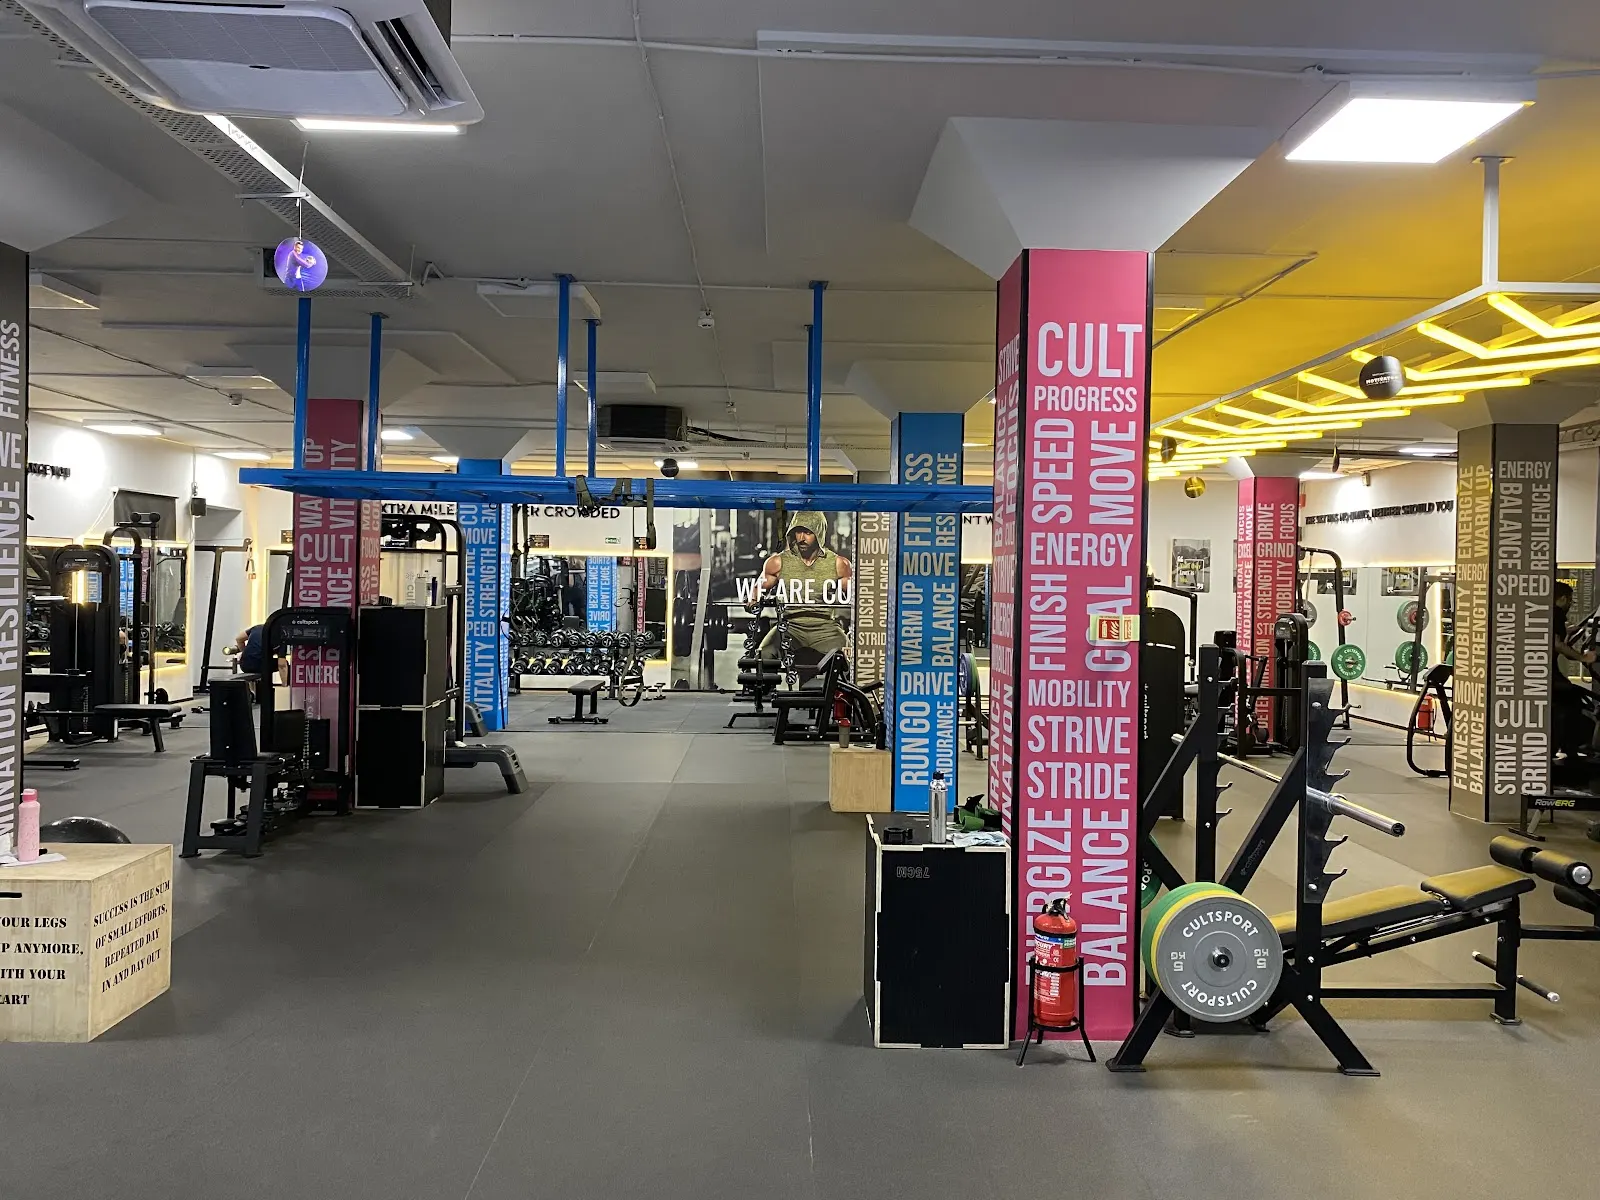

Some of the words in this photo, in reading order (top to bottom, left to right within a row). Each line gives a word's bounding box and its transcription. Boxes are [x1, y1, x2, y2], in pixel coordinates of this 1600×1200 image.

[1037, 321, 1143, 378] CULT
[0, 320, 20, 419] FITNESS
[1034, 385, 1137, 413] PROGRESS
[305, 438, 324, 463] UP
[1006, 379, 1019, 515] FOCUS
[330, 439, 355, 529] VITITY
[995, 394, 1007, 548] BALANCE
[1031, 418, 1074, 524] SPEED
[1088, 420, 1136, 526] MOVE
[1475, 464, 1492, 495] UP
[1499, 461, 1551, 479] ENERGY
[382, 503, 416, 515] XTRA
[420, 503, 456, 516] MILE
[904, 453, 933, 547] FITSS
[1457, 465, 1473, 559] ENERGIZE
[464, 528, 496, 544] MOVE
[1245, 504, 1253, 540] MOVE
[1257, 503, 1274, 540] DRIVE
[1280, 503, 1295, 539] FOCUS
[1474, 499, 1491, 558] WARM
[1498, 482, 1523, 571] BALANCE
[1530, 483, 1551, 571] RESILIENCE
[300, 533, 353, 563] CULT
[860, 537, 889, 555] MOV
[903, 551, 955, 577] MOVE
[1031, 532, 1133, 567] ENERGY
[1256, 543, 1294, 558] GRIND
[479, 549, 497, 618] STRENGTH
[735, 577, 768, 603] WE
[776, 578, 815, 604] ARE
[1256, 560, 1272, 620] STRENGTH
[1456, 563, 1488, 581] ENERGY
[1497, 574, 1550, 597] SPEED
[859, 559, 875, 628] DISCIPLINE
[902, 581, 925, 605] UP
[467, 621, 495, 637] PEED
[858, 631, 887, 646] STRID
[901, 610, 923, 666] WARM
[932, 582, 955, 667] BALANCE
[1029, 574, 1067, 671] FINISH
[1456, 586, 1471, 677] MOBILITY
[1471, 583, 1487, 679] STRENGTH
[1495, 602, 1516, 696] ENDURANCE
[1523, 600, 1550, 696] MOBILITY
[474, 641, 495, 712] VITALITY
[900, 671, 954, 696] DRIVE
[1028, 679, 1131, 708] MOBILITY
[1454, 679, 1485, 708] MOVE
[900, 701, 931, 734] GO
[1494, 699, 1548, 729] CULT
[936, 701, 954, 787] ENDURANCE
[1027, 715, 1131, 754] STRIVE
[1453, 708, 1469, 791] FITNESS
[1469, 710, 1485, 795] BALANCE
[901, 738, 930, 786] RUN
[1027, 761, 1130, 800] STRIDE
[1494, 733, 1517, 796] STRIVE
[1521, 732, 1548, 797] GRIND
[1535, 798, 1575, 808] RowERG
[93, 901, 129, 928] SUCCESS
[130, 896, 138, 909] IS
[139, 889, 155, 905] THE
[155, 880, 170, 896] SUM
[1081, 808, 1129, 986] BALANCE
[0, 916, 30, 928] OUR
[34, 916, 67, 928] LEGS
[95, 935, 107, 950] OF
[107, 921, 133, 944] SMALL
[1182, 910, 1259, 938] CULTSPORT
[0, 943, 11, 953] P
[14, 943, 84, 956] ANYMORE,
[104, 937, 144, 968] REPEATED
[146, 928, 160, 945] DAY
[1170, 951, 1186, 960] KG
[1253, 948, 1269, 957] KG
[0, 968, 25, 979] ITH
[30, 968, 66, 979] YOUR
[102, 979, 111, 993] IN
[112, 969, 129, 987] AND
[130, 957, 146, 976] DAY
[146, 949, 161, 965] OUT
[1181, 979, 1258, 1007] CULTSPORT
